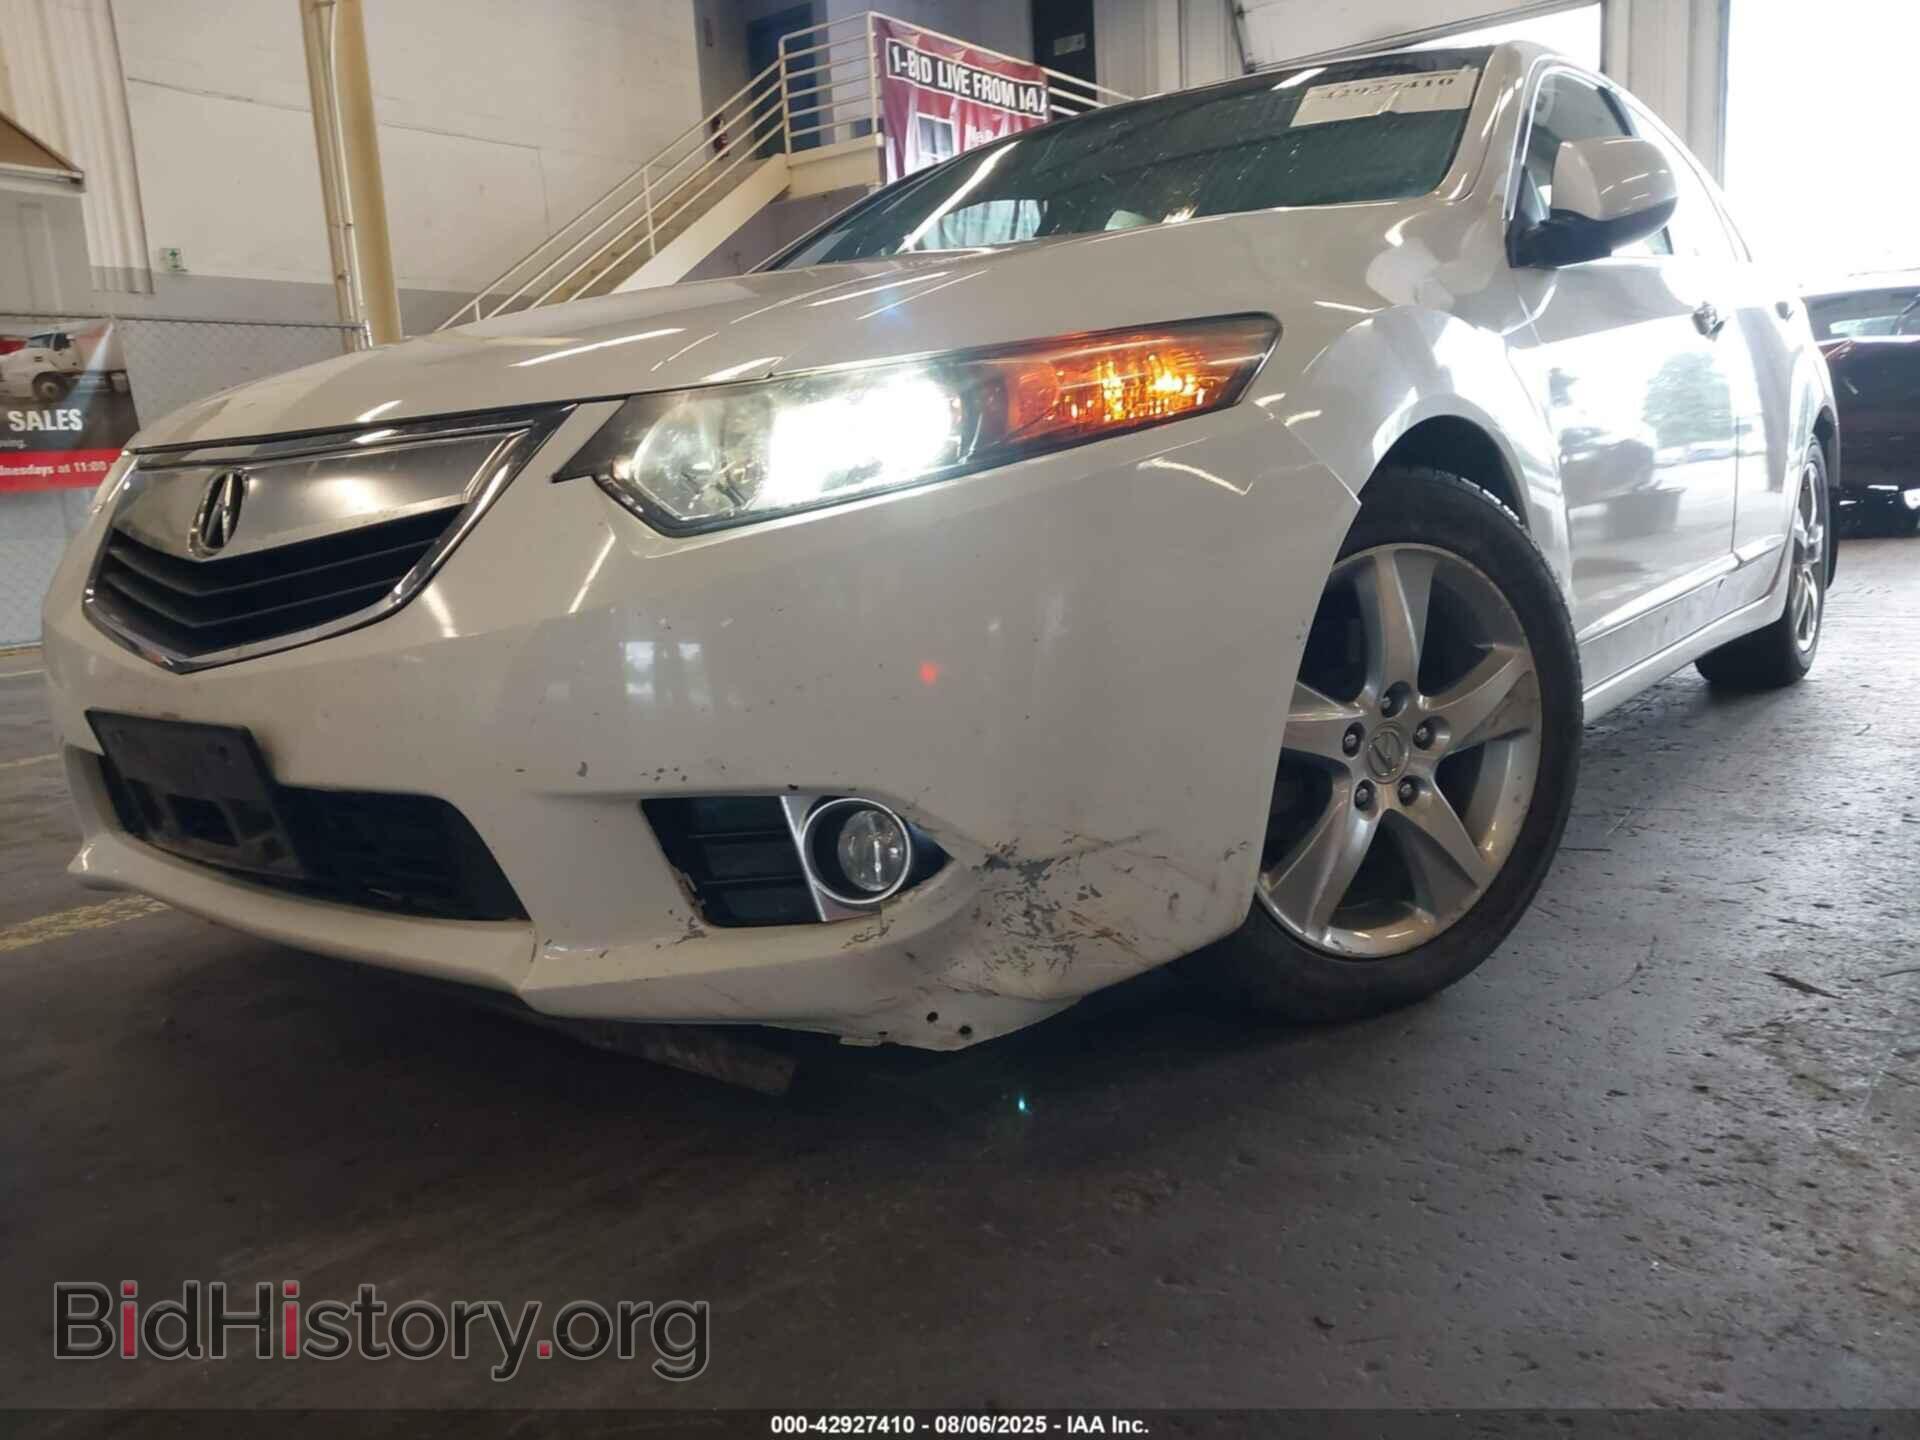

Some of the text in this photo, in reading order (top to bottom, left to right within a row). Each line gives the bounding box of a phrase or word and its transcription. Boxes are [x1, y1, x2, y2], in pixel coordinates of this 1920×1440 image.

[937, 60, 971, 95] LIVE
[973, 73, 1015, 108] FROM
[7, 408, 84, 432] SALES
